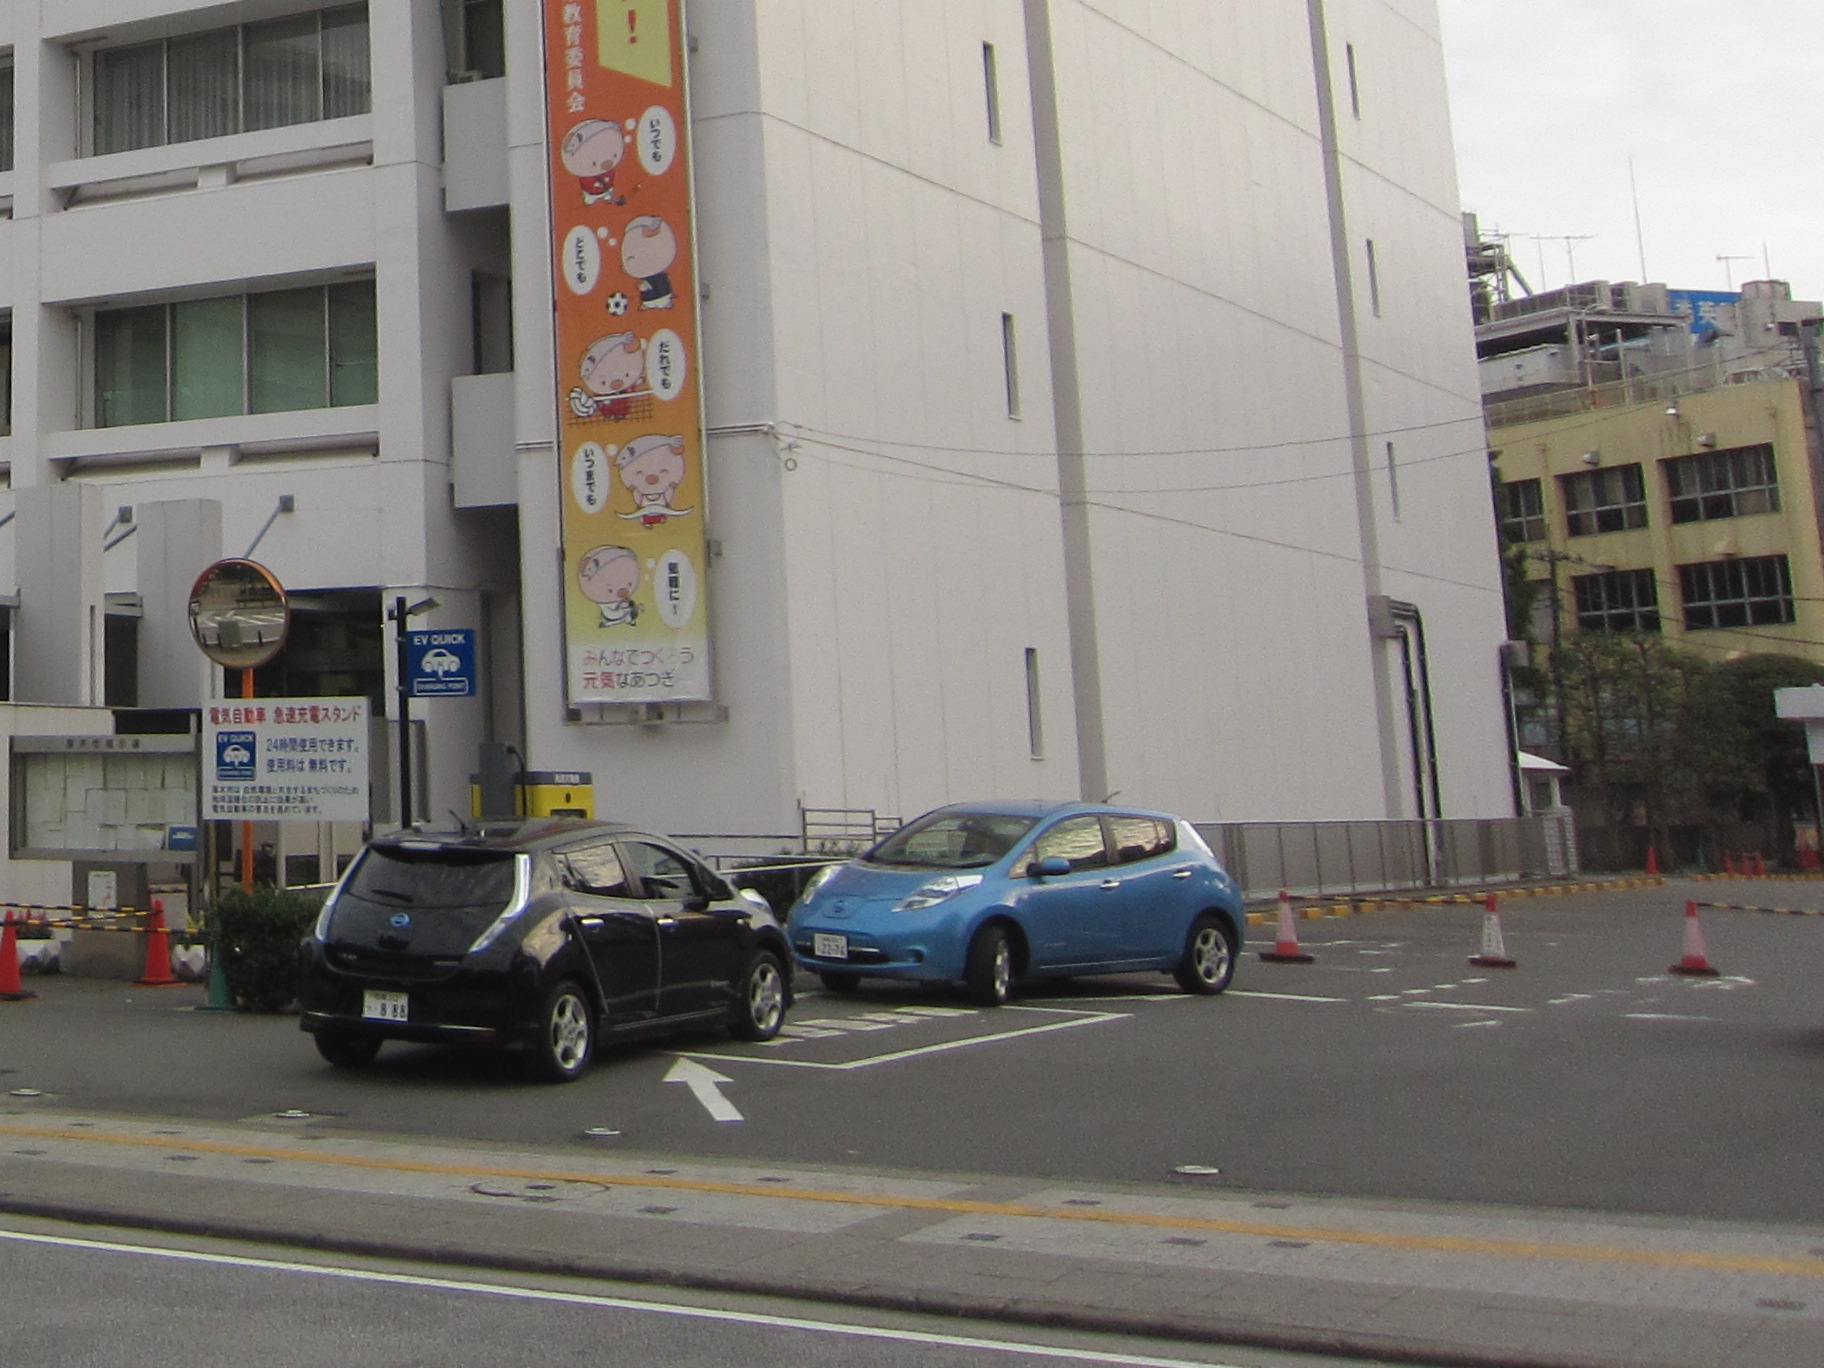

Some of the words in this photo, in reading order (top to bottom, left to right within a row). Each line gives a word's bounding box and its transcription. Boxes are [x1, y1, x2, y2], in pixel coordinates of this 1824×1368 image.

[650, 119, 662, 162] いつでも
[659, 341, 671, 389] だれでも
[585, 448, 596, 505] いつまでも
[413, 634, 429, 645] EV
[431, 633, 466, 645] QUICK
[583, 669, 675, 689] 元気なあつぎ
[210, 706, 267, 724] 電気自動車
[274, 705, 361, 723] 急速充電スタンド
